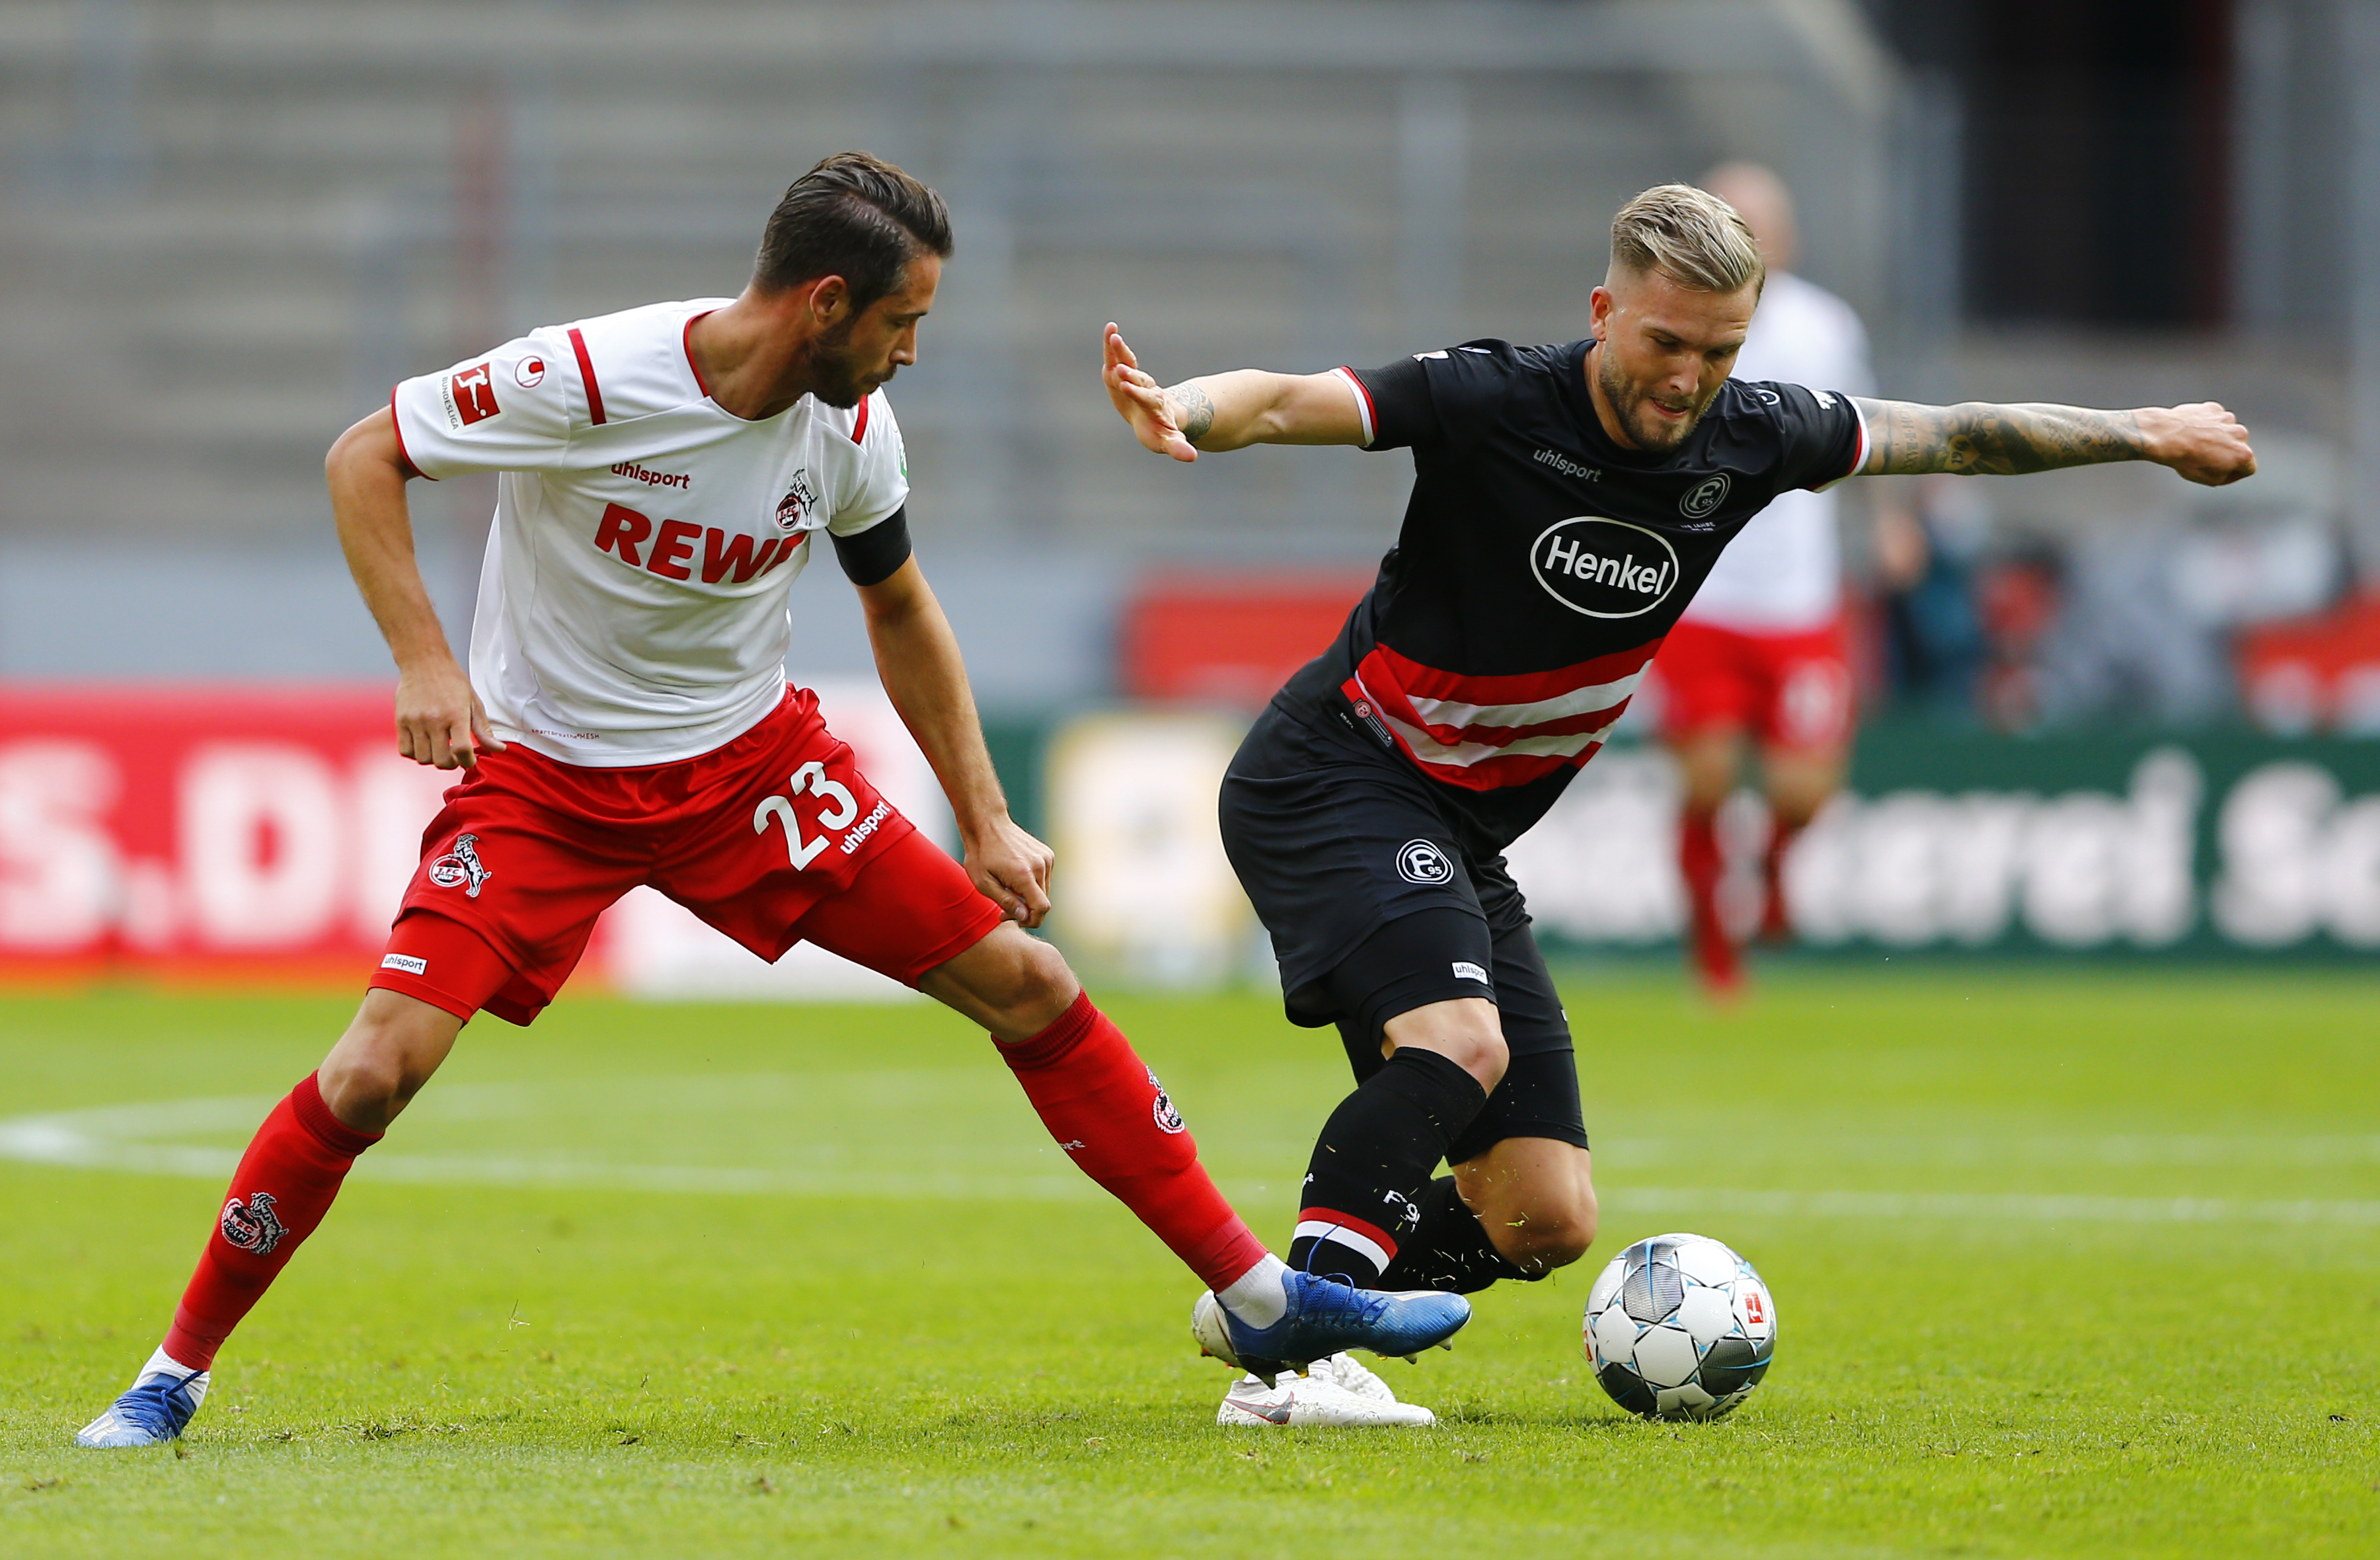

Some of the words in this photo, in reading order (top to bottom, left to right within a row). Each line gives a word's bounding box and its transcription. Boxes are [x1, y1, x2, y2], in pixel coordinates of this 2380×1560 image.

[441, 376, 459, 430] BUNDESLIGA
[611, 462, 690, 488] uhlsport
[1533, 449, 1601, 482] uhlsport
[1545, 535, 1670, 595] Henkel
[753, 761, 858, 871] 23
[839, 800, 890, 855] uhlsport
[385, 956, 424, 970] uhlsport
